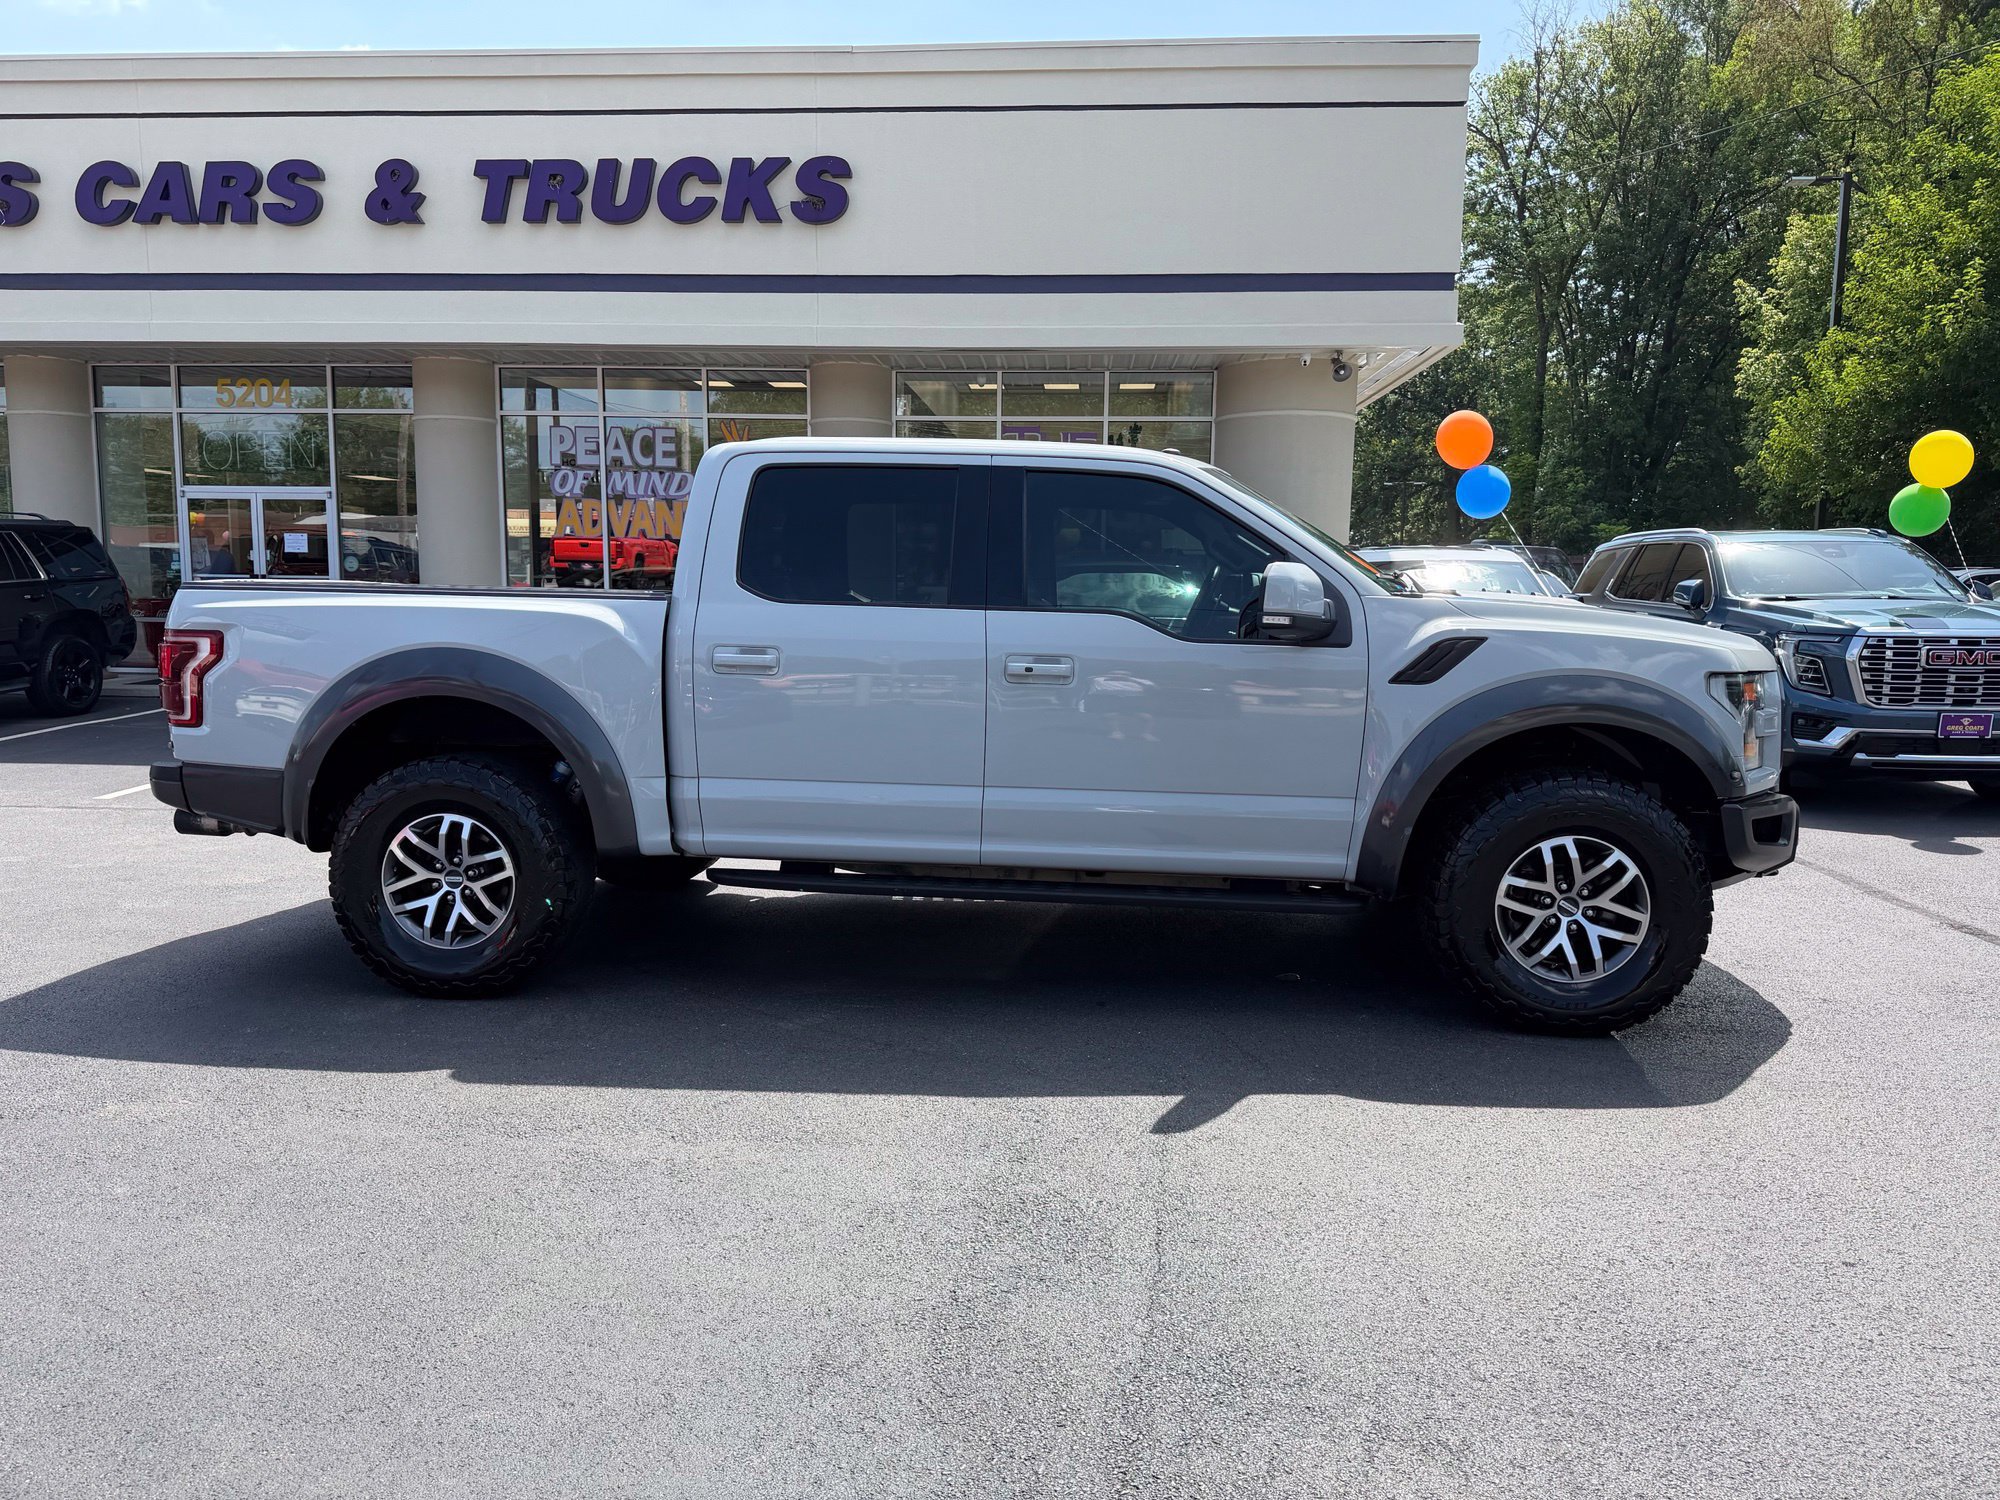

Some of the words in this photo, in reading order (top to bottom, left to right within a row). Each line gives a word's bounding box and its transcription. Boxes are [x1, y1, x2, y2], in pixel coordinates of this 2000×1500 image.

[75, 159, 326, 227] CARS
[364, 158, 427, 225] &
[473, 155, 853, 226] TRUCKS
[216, 378, 292, 408] 5204
[203, 431, 315, 470] OPEN
[549, 425, 678, 468] PEACE
[551, 469, 596, 498] OF
[607, 470, 694, 499] MIND
[554, 498, 690, 539] ADVAN
[1929, 650, 2000, 665] GMC
